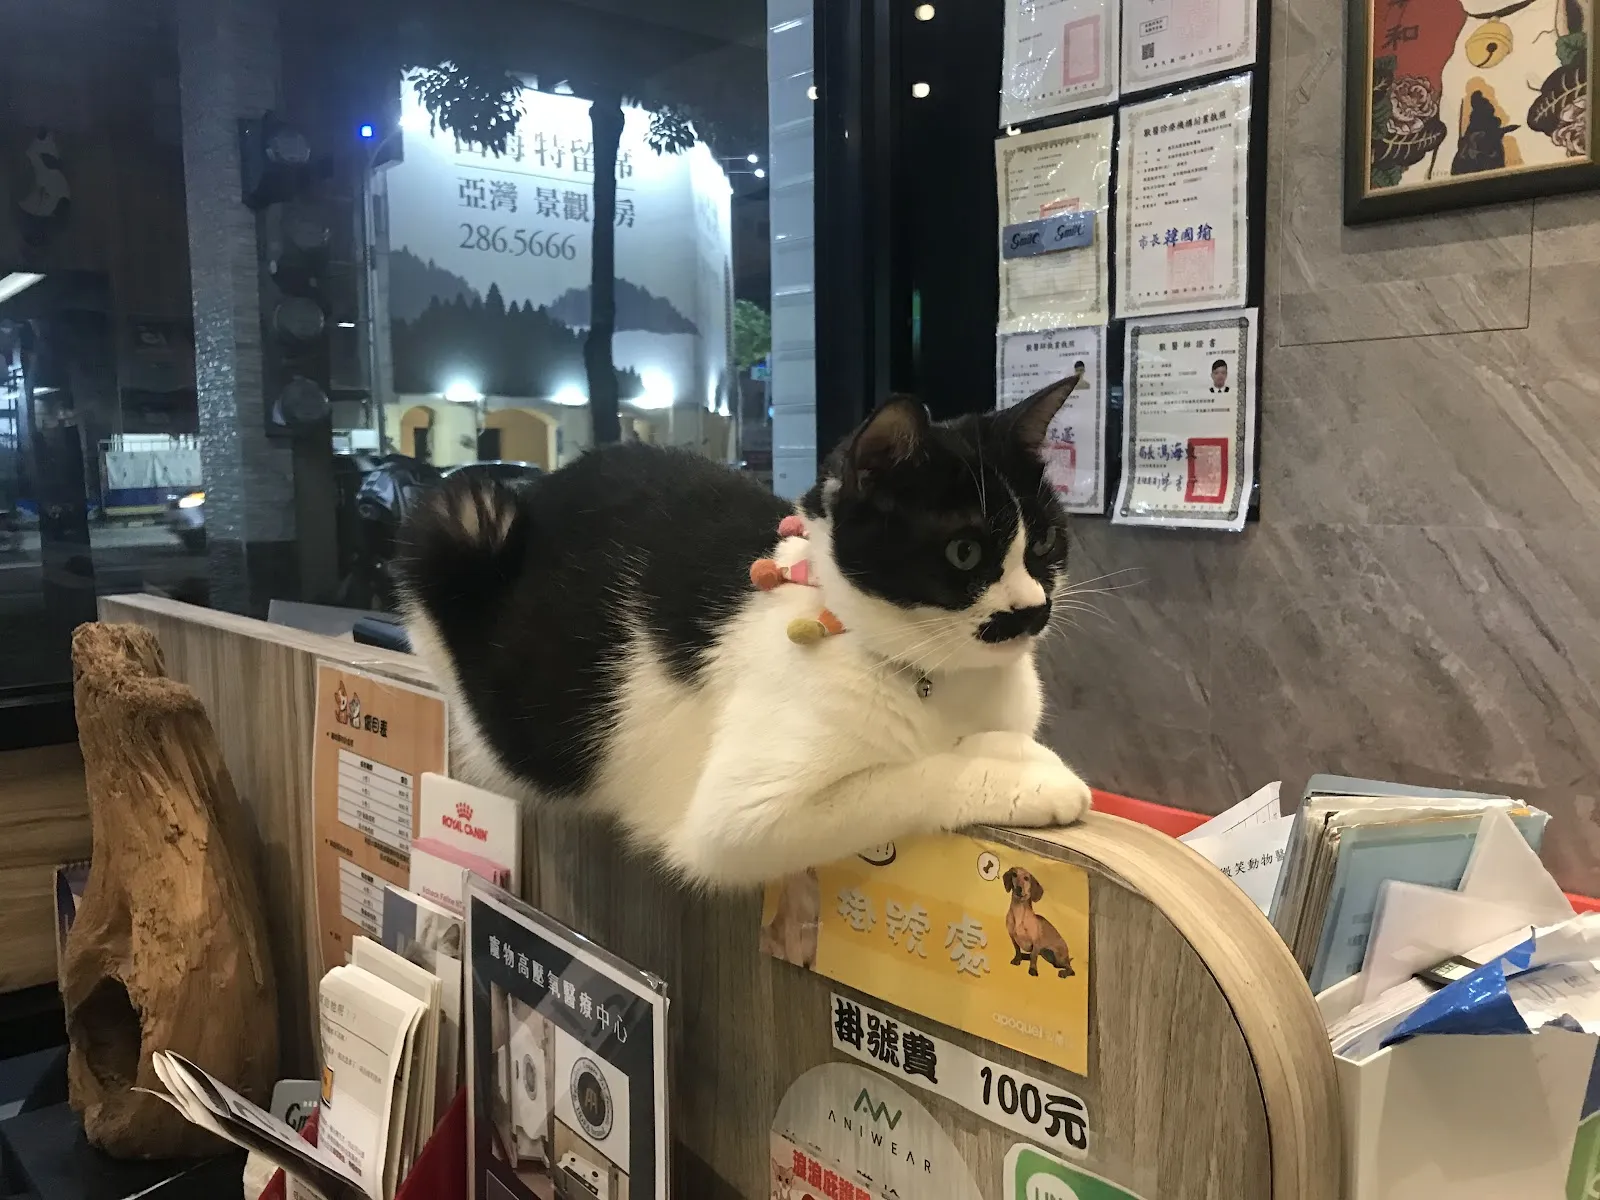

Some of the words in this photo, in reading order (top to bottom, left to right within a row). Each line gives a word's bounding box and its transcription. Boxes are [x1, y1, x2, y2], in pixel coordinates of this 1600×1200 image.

[459, 223, 576, 260] 286.5666
[442, 815, 463, 833] ROYAL
[464, 823, 488, 842] CANIN
[489, 935, 628, 1044] 寵物高壓氧醫療中心
[834, 998, 938, 1085] 掛號費
[980, 1066, 1087, 1150] 100元
